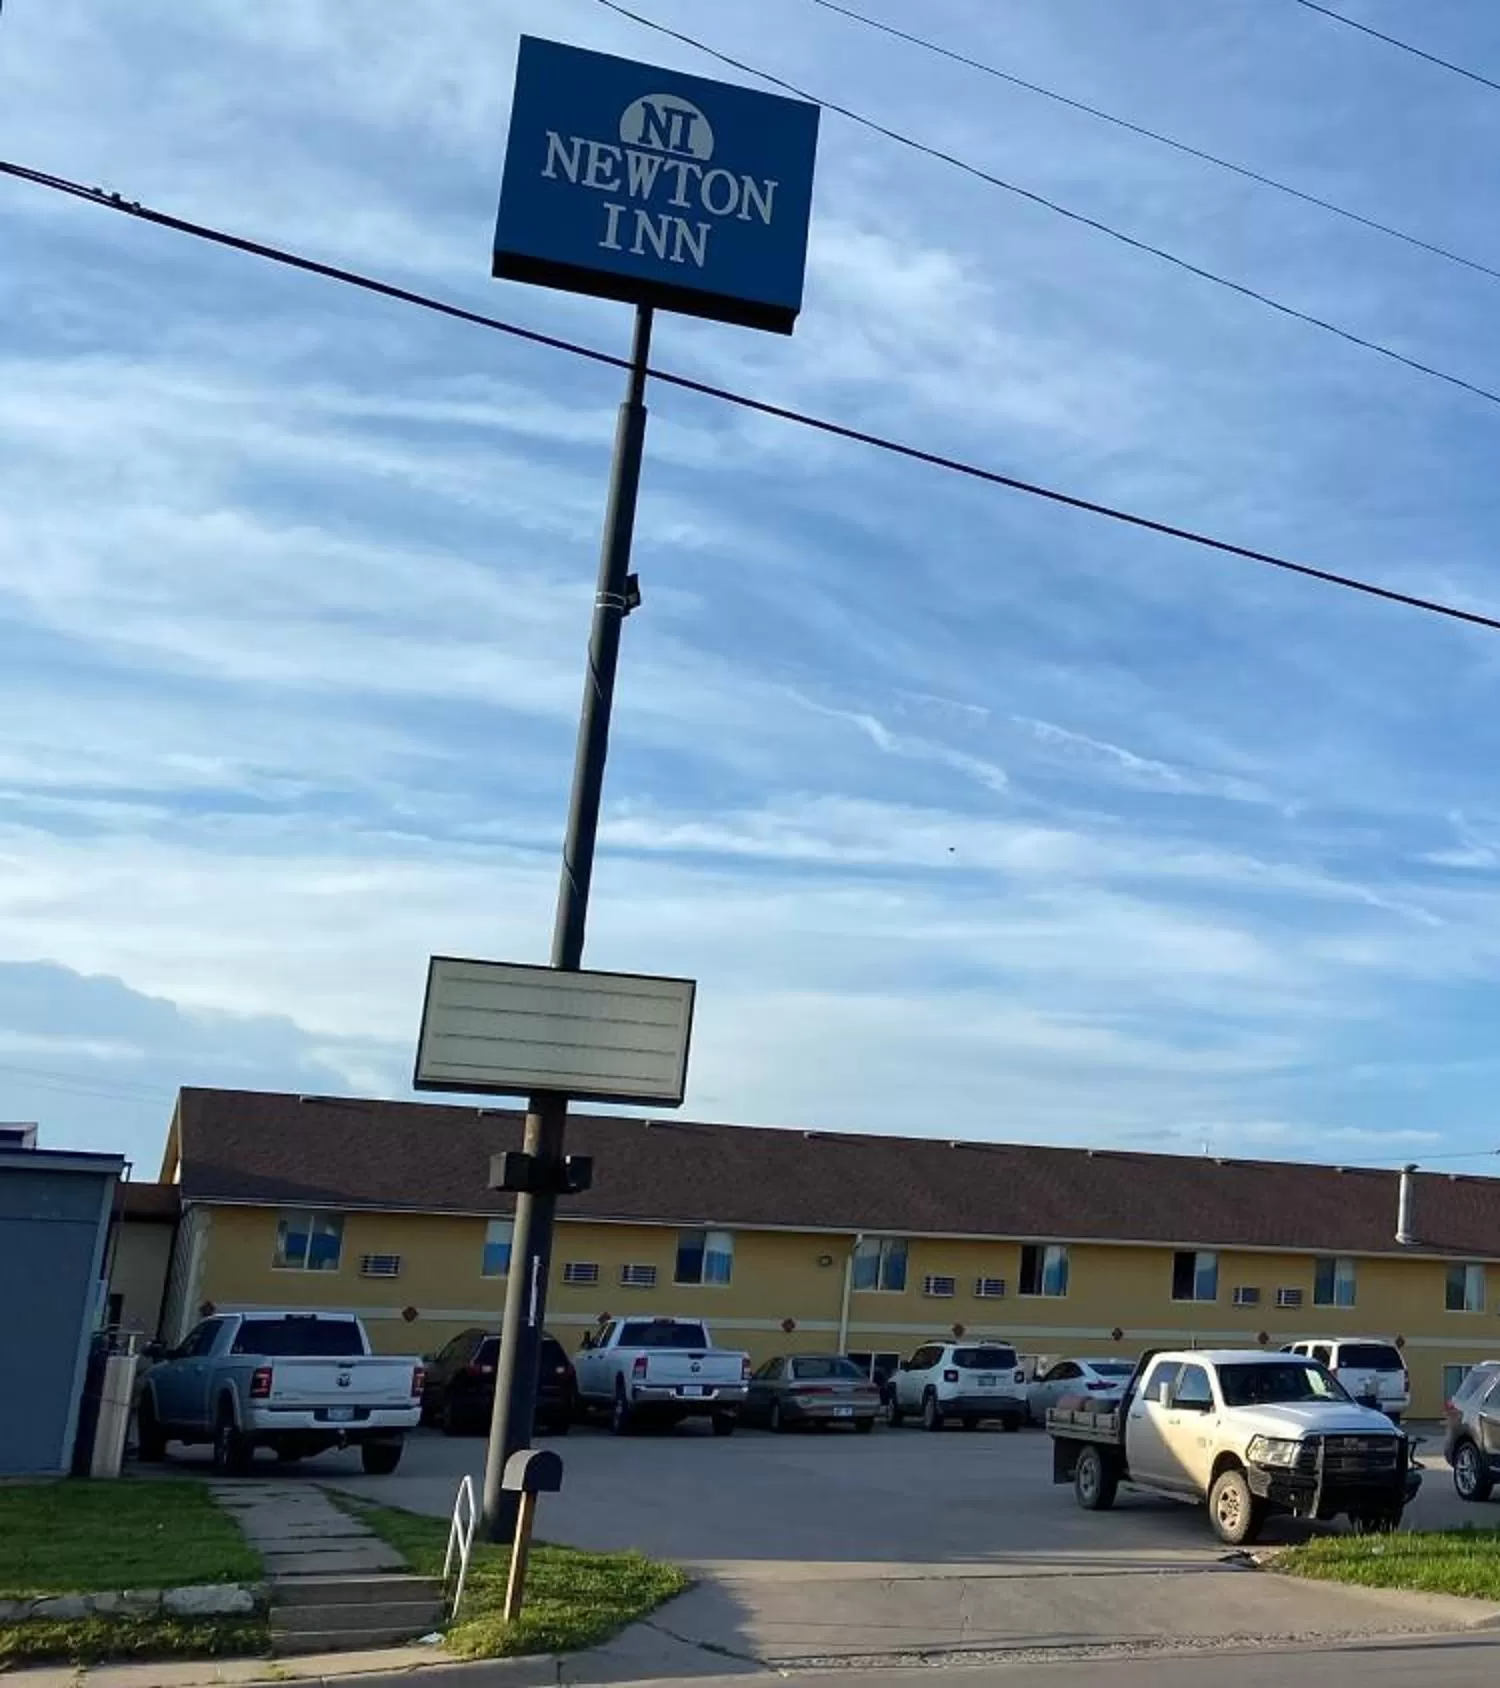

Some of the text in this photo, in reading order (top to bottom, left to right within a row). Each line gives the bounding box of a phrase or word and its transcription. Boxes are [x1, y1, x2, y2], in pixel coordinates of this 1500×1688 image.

[636, 100, 699, 156] NI
[540, 128, 779, 225] NEWTON
[597, 201, 712, 268] INN
